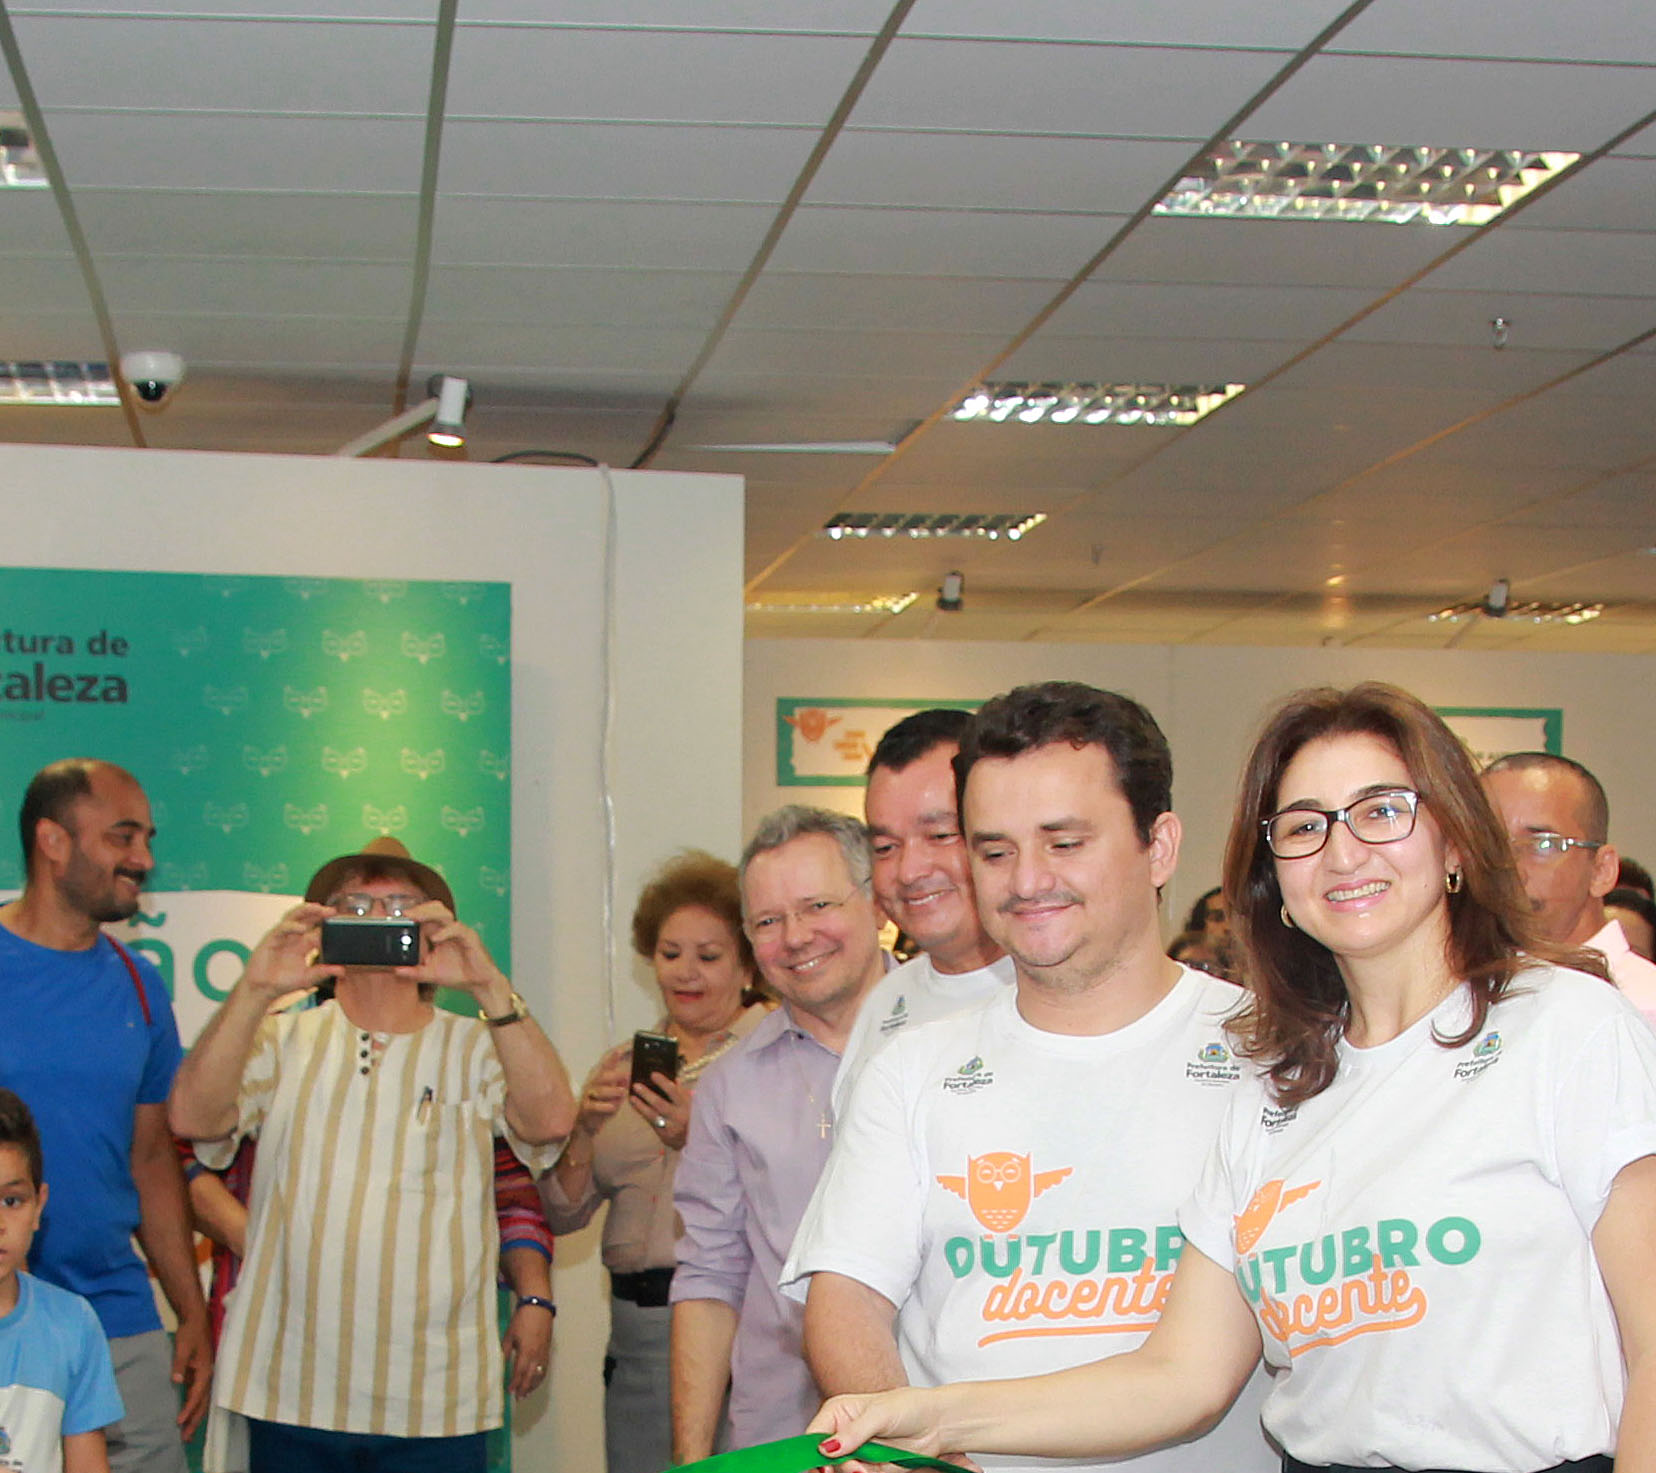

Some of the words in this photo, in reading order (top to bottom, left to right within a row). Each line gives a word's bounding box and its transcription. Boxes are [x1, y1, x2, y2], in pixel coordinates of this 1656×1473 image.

[87, 629, 130, 658] de
[1186, 1069, 1241, 1080] Fortaleza
[944, 1225, 1186, 1279] OUTUBR
[1237, 1216, 1482, 1304] UTUBRO
